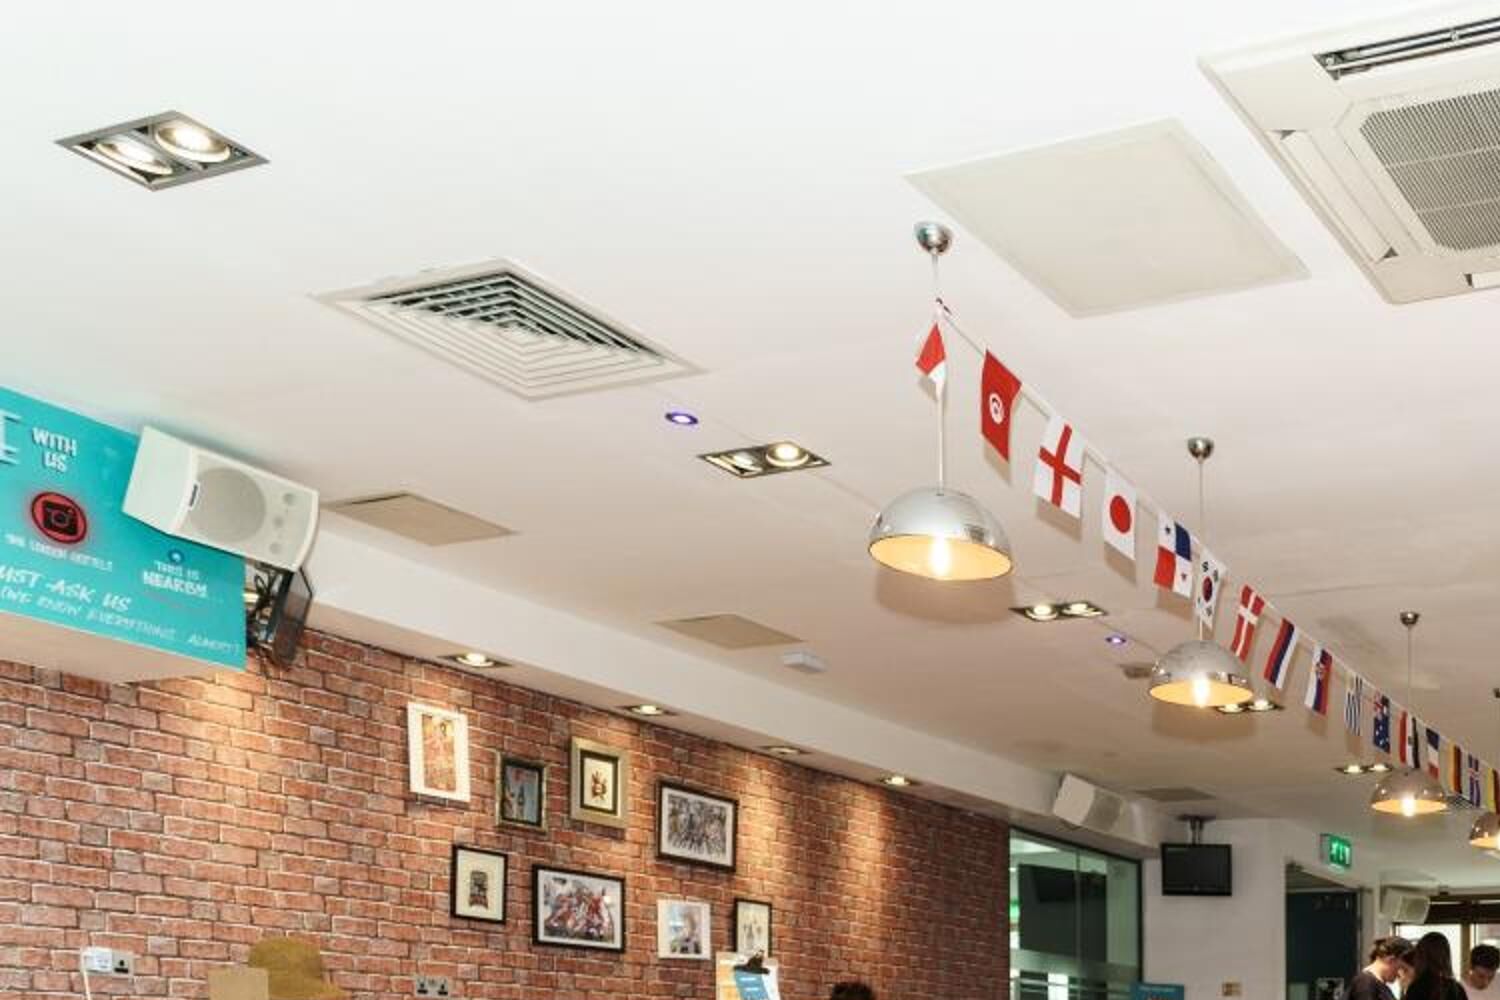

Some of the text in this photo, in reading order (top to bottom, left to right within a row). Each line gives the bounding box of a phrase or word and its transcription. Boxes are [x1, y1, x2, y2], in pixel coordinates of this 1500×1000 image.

[32, 427, 77, 457] WITH
[44, 452, 68, 473] US
[0, 564, 132, 612] UST ASK US
